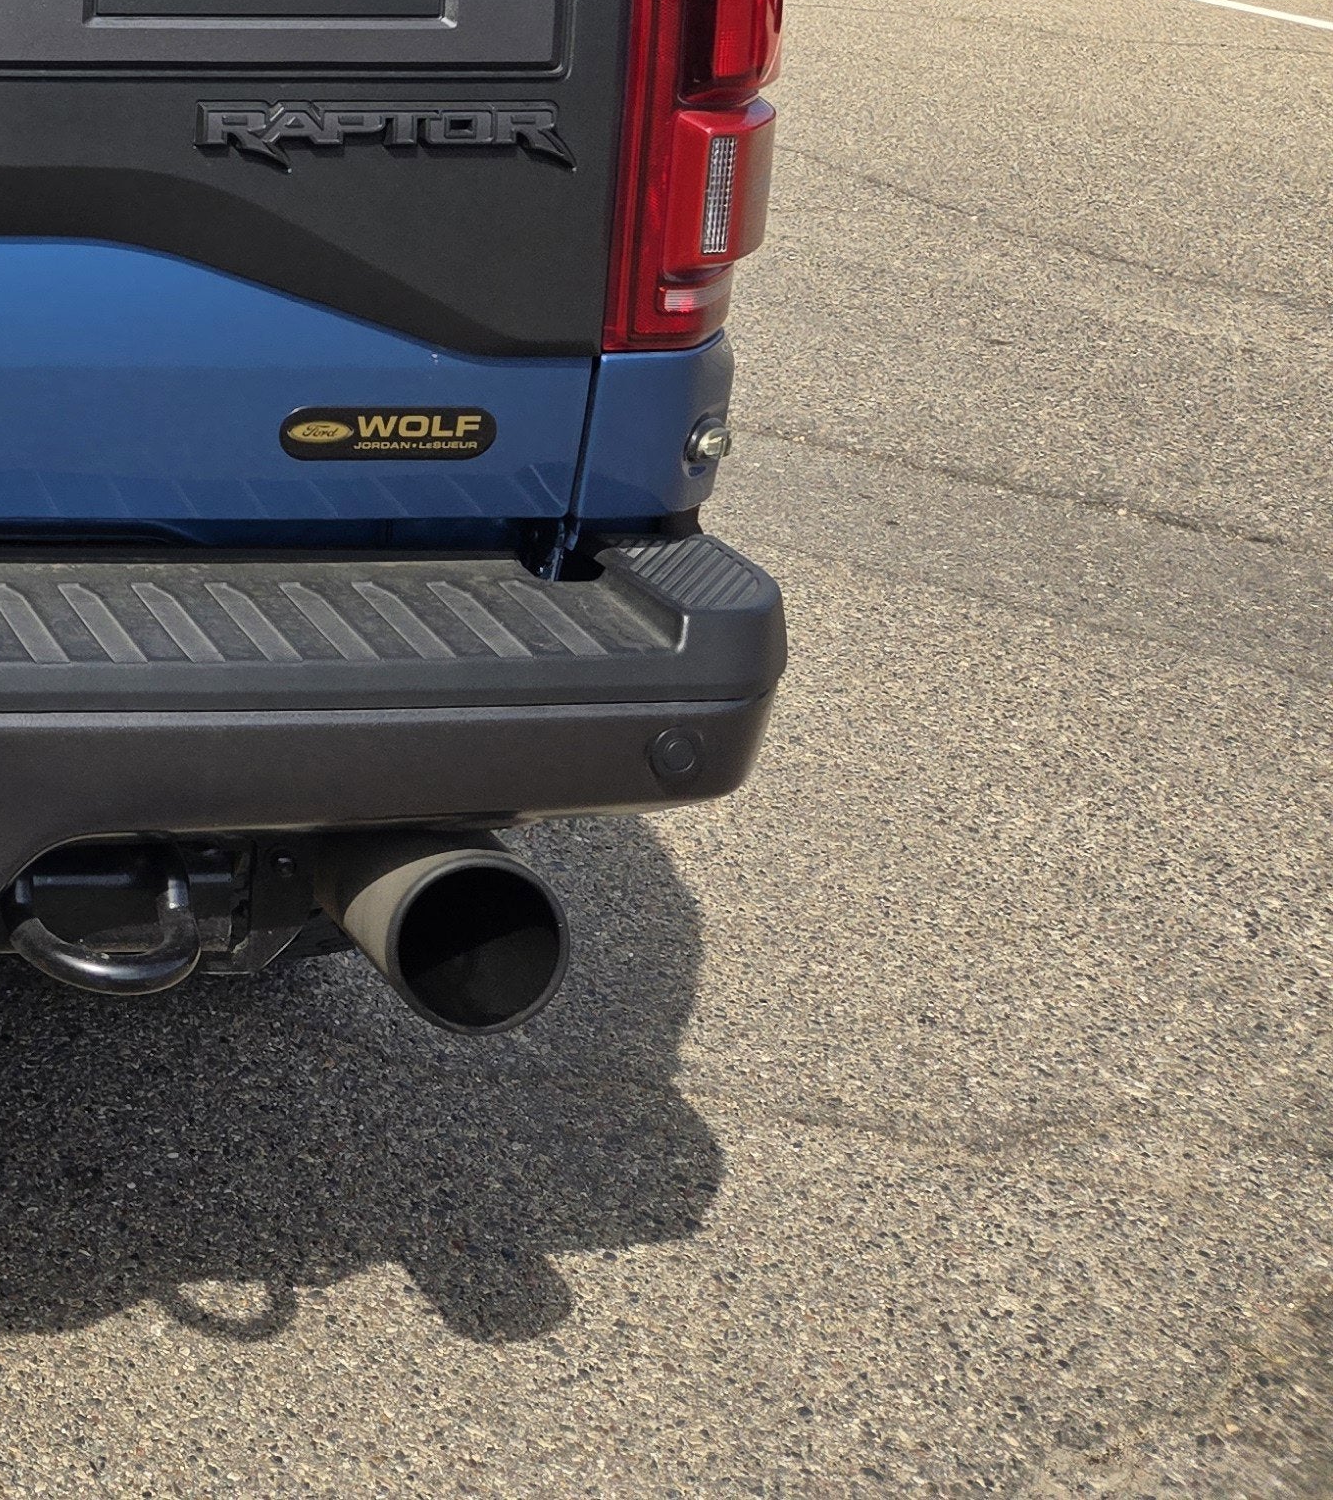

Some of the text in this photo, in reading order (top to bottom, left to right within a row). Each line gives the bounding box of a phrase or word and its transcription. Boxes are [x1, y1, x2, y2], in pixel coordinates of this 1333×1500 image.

[194, 100, 577, 173] RAPTOR
[302, 424, 338, 438] Ford
[357, 415, 482, 438] WOLF
